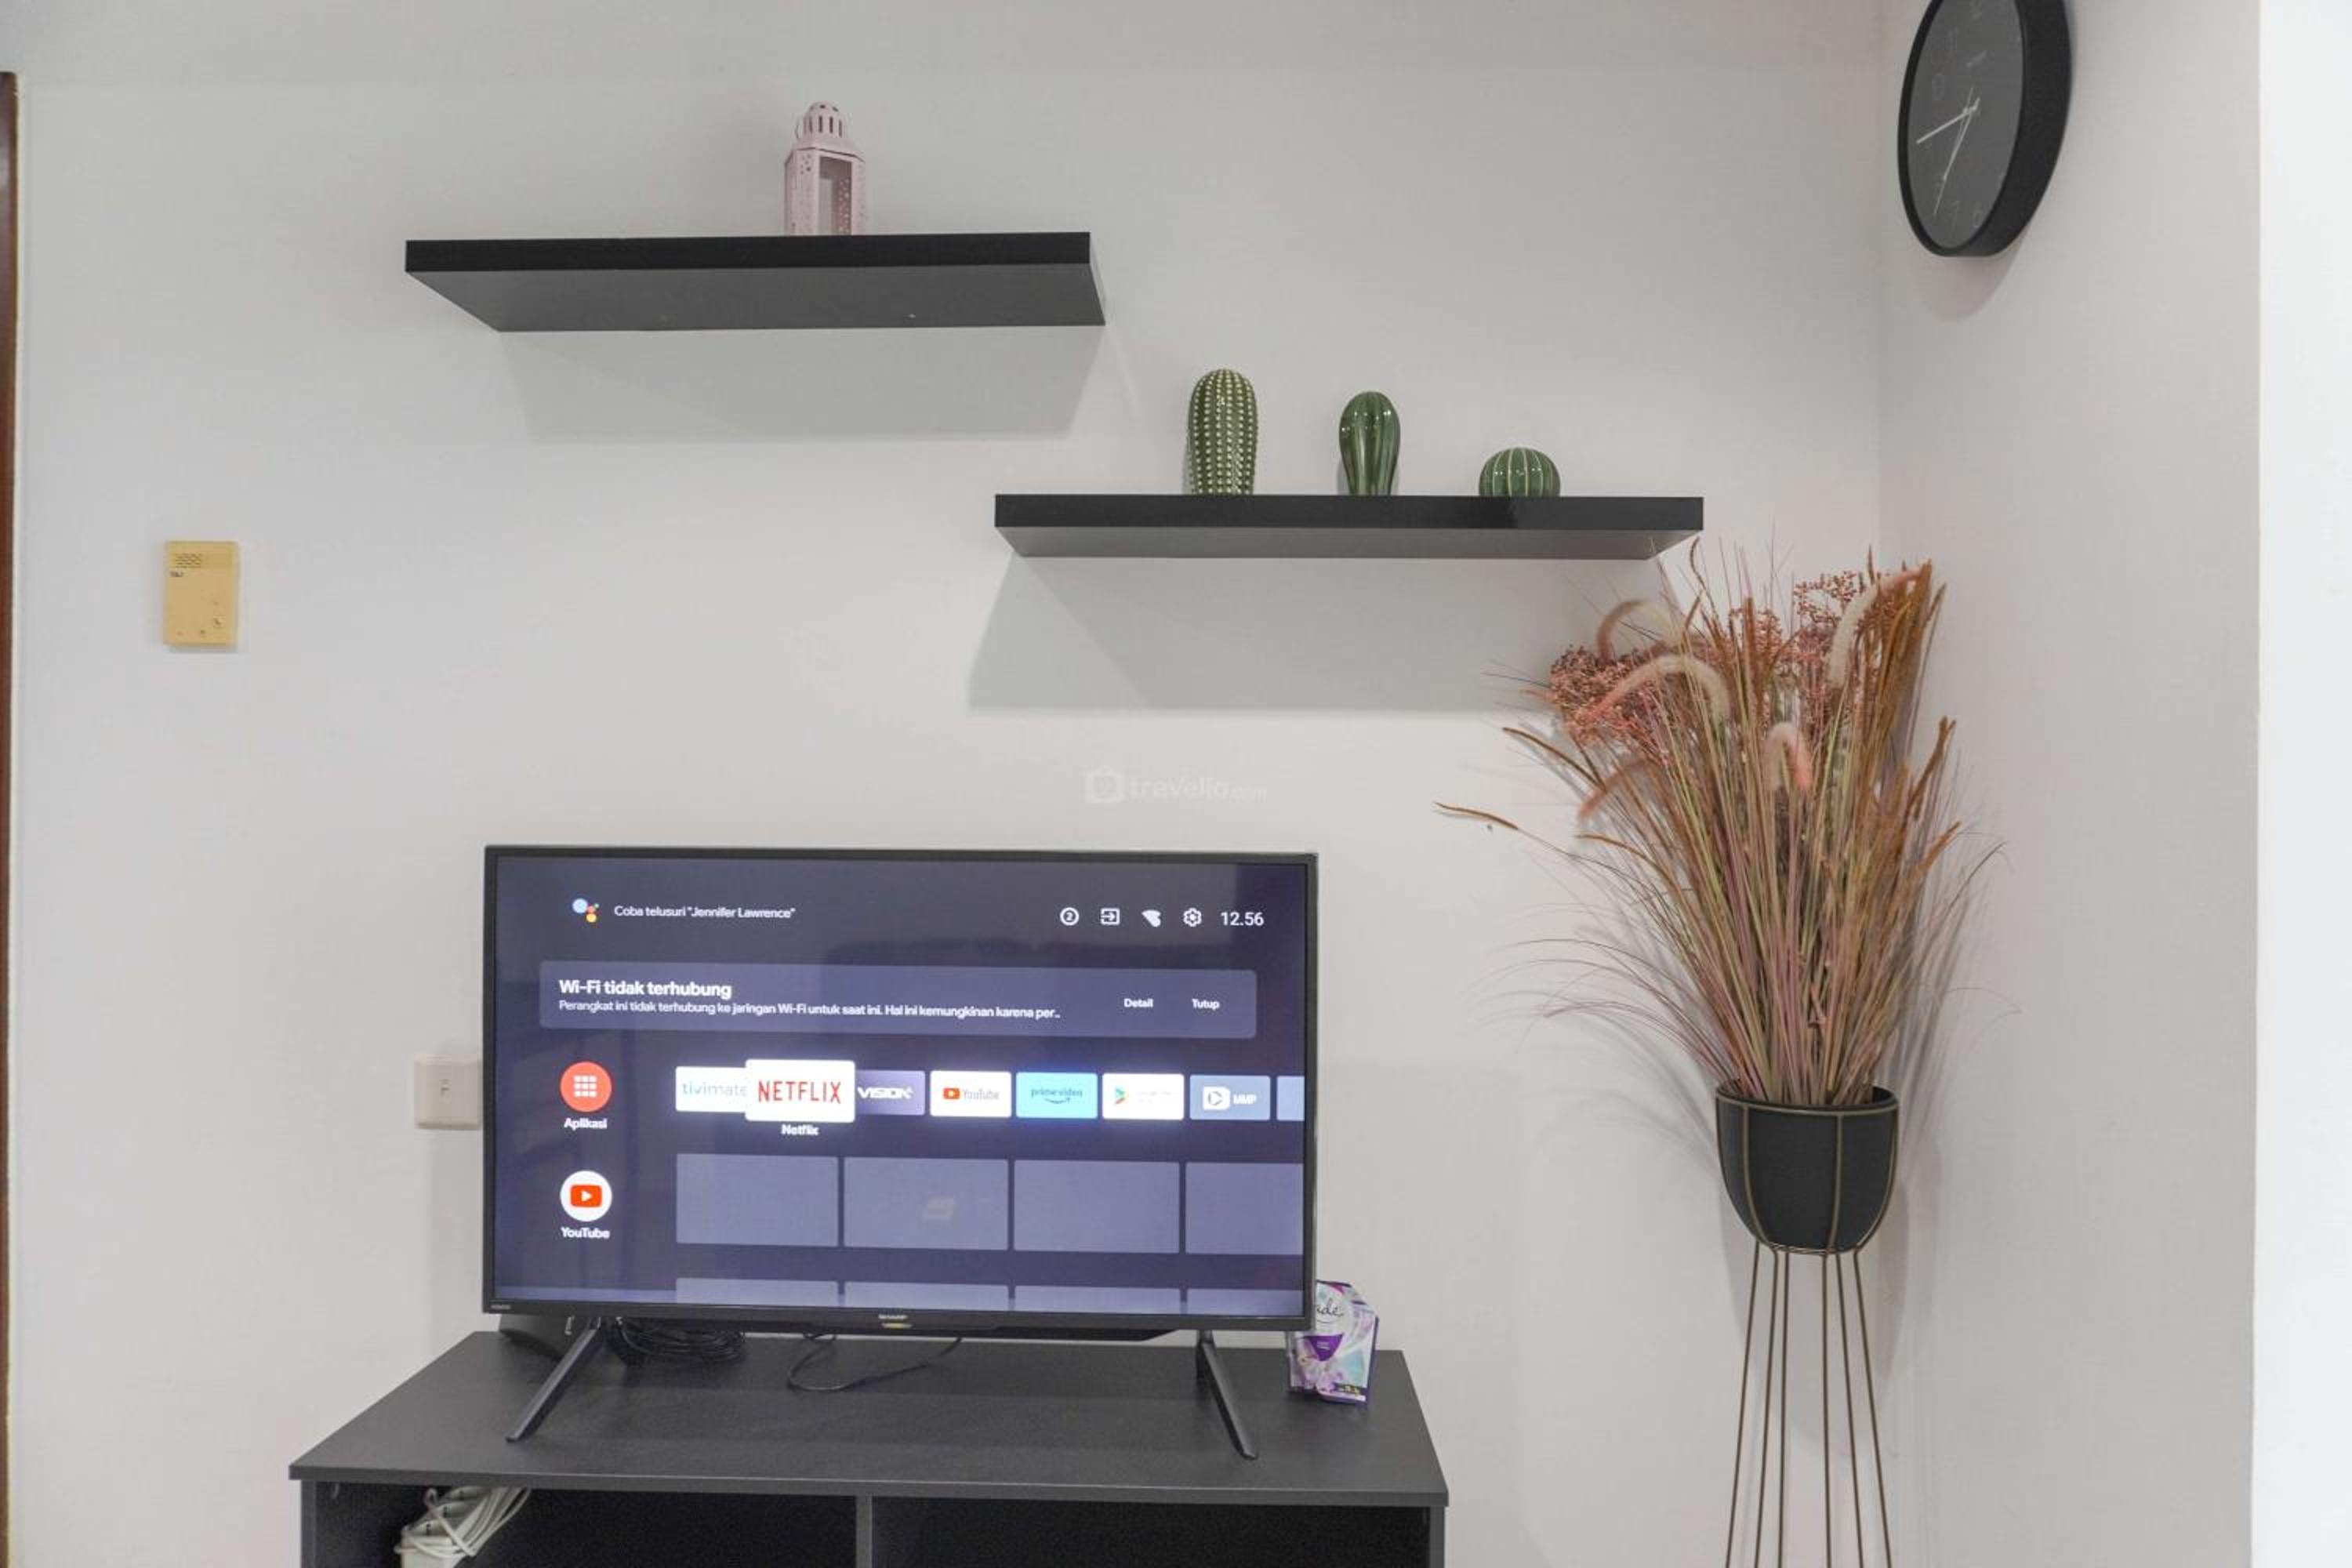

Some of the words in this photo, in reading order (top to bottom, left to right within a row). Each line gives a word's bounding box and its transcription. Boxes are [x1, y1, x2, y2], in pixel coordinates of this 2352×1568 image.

[614, 905, 644, 916] Coba
[645, 906, 686, 916] telusuri
[1221, 912, 1265, 927] 12.56
[559, 979, 601, 994] Wi-Fi
[604, 980, 644, 996] tidak
[647, 982, 732, 1000] terhubung
[559, 1000, 614, 1013] Perangkat
[615, 1000, 627, 1011] ini
[630, 1001, 655, 1011] tidak
[659, 1002, 716, 1014] terhubung
[717, 1003, 731, 1013] ke
[732, 1004, 776, 1016] jaringan
[778, 1004, 807, 1014] Wi-Fi
[808, 1004, 840, 1014] untuk
[842, 1004, 865, 1015] saat
[885, 1004, 902, 1015] Hal
[904, 1004, 917, 1015] ini
[919, 1005, 994, 1019] kemungkinan
[996, 1006, 1033, 1018] karena
[1123, 998, 1154, 1008] Detail
[1192, 998, 1220, 1010] Tutup
[758, 1080, 841, 1104] NETFLIX
[963, 1087, 1000, 1100] YouTube
[564, 1117, 608, 1131] Aplikasi
[781, 1124, 819, 1136] Netflix
[561, 1227, 611, 1240] YouTube
